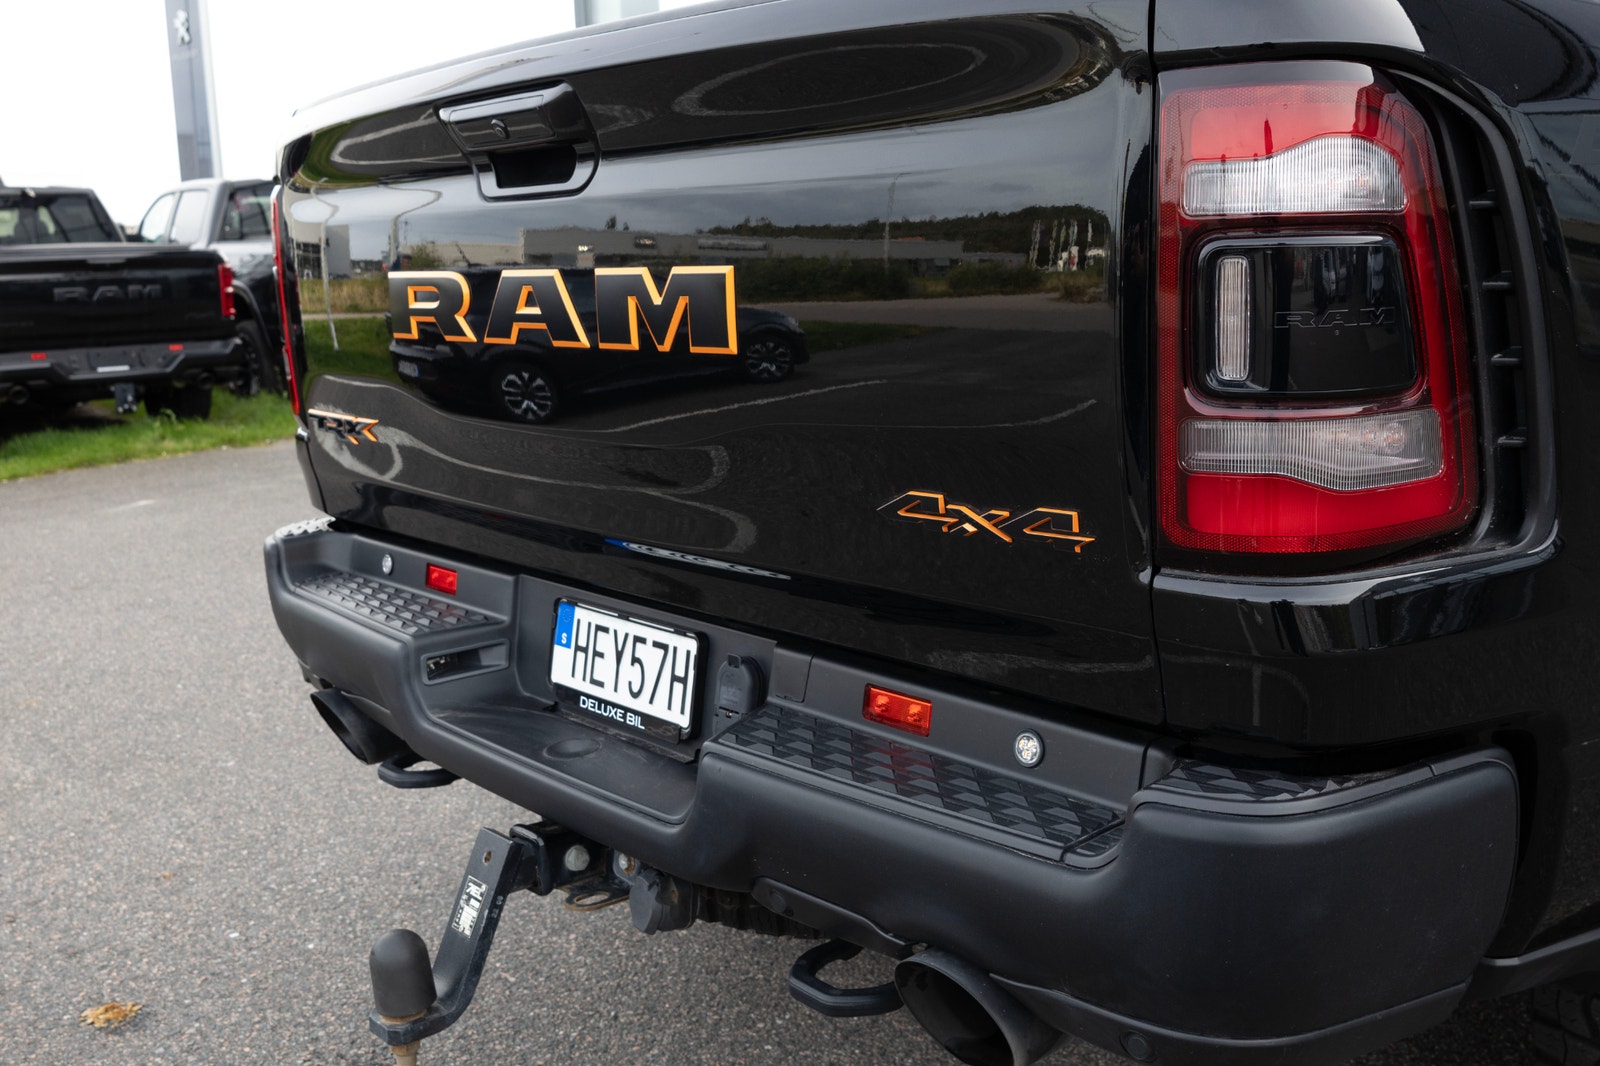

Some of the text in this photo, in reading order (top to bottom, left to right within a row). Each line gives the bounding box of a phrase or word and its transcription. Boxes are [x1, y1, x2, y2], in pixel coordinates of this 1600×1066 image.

[53, 283, 163, 301] RAM
[388, 265, 738, 355] RAM
[1274, 307, 1396, 329] RAM
[307, 408, 379, 445] TRX
[561, 632, 567, 645] S
[571, 618, 691, 716] HEY57H
[579, 695, 646, 730] DELUXE BIL
